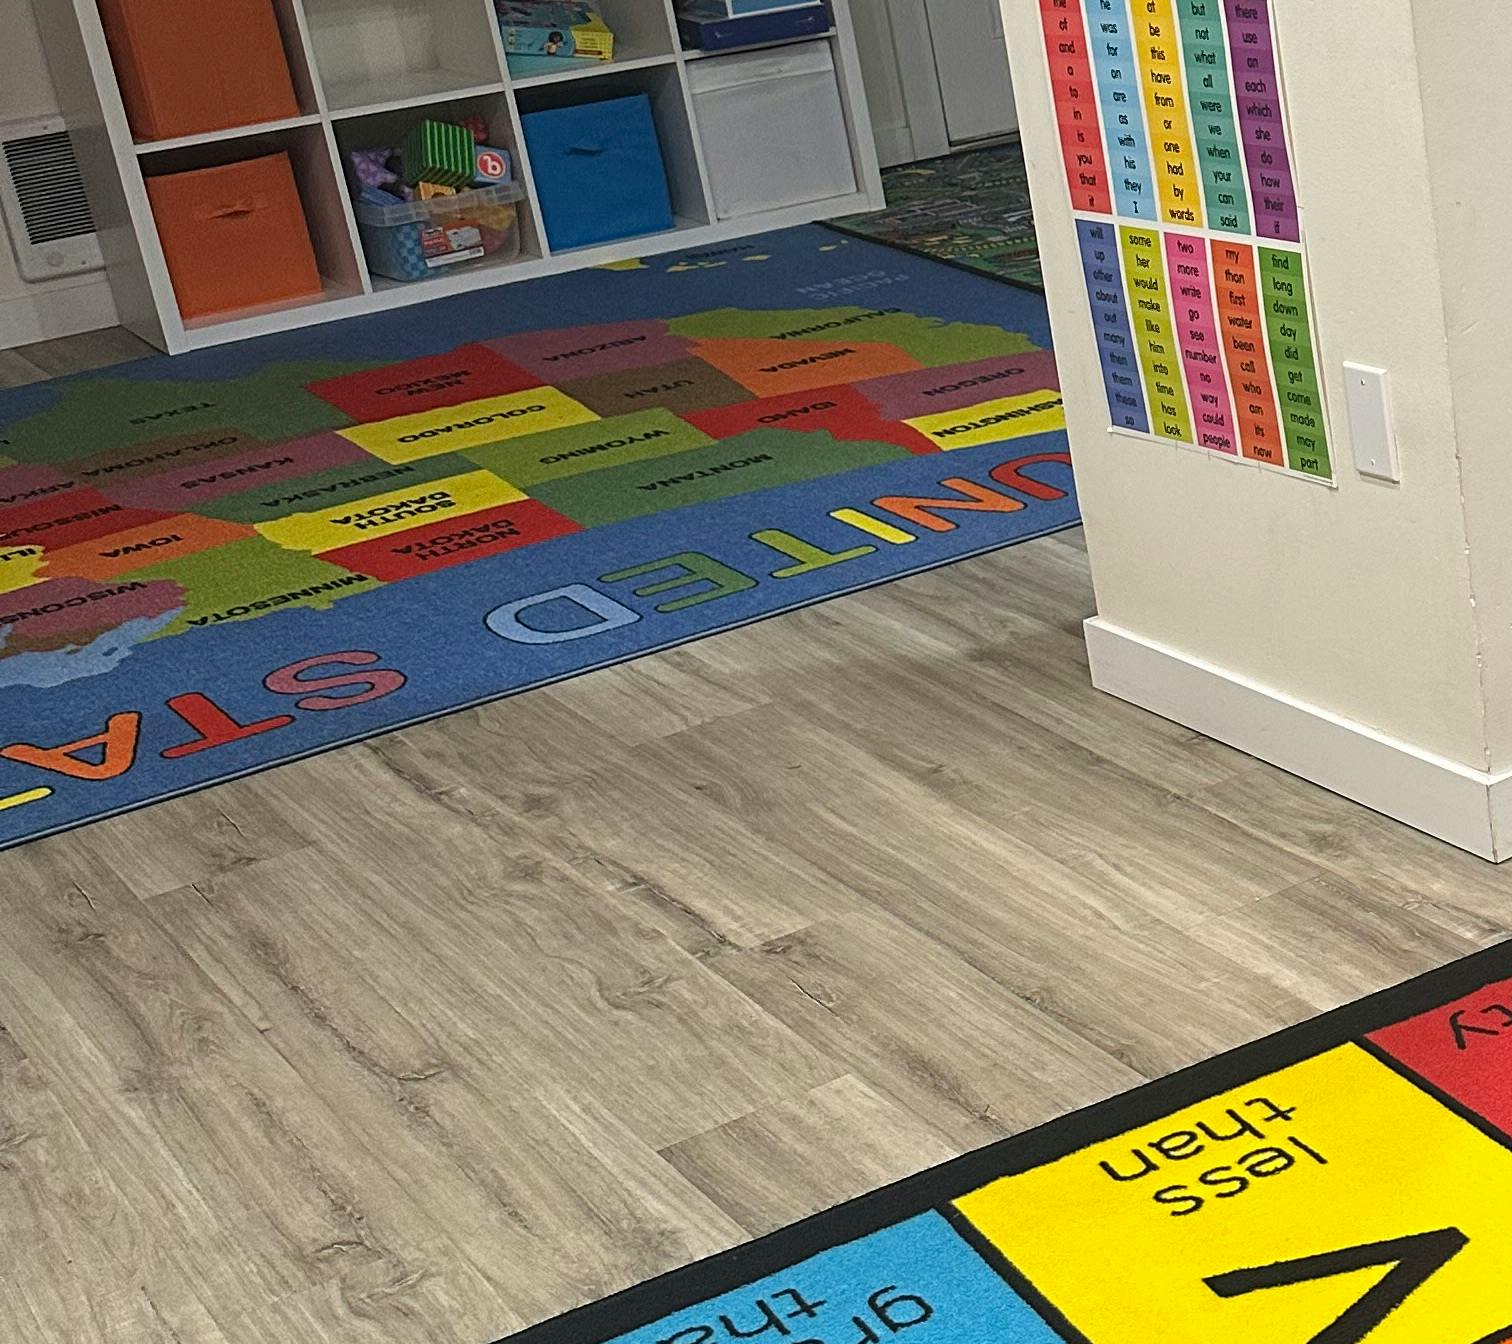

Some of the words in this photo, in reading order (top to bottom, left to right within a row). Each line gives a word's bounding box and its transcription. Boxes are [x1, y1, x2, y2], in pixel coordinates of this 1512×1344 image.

[1151, 70, 1171, 84] have
[1207, 144, 1231, 159] when
[1272, 254, 1289, 270] find
[796, 269, 887, 296] OCEAN
[1273, 277, 1293, 296] long
[1273, 300, 1298, 316] down
[769, 306, 902, 341] CALIFORNIA
[1280, 324, 1296, 341] day
[541, 335, 647, 362] ARIZONA
[757, 347, 856, 374] NEVADA
[375, 369, 472, 396] MEXICO
[407, 379, 465, 397] NEW
[624, 379, 696, 400] UTAH
[922, 367, 1026, 398] OREGON
[1288, 371, 1302, 384] get
[129, 401, 216, 426] TEXAS
[396, 404, 547, 443] COLORADO
[757, 400, 839, 425] IDAHO
[81, 435, 239, 478] OKLAHOMA
[538, 428, 671, 465] WYOMING
[180, 457, 295, 490] KANSAS
[259, 465, 416, 508] NEBRASKA
[636, 453, 774, 492] MONTANA
[330, 491, 451, 526] DAKOTA
[354, 499, 457, 530] SOUTH
[99, 533, 185, 558] IOWA
[391, 519, 516, 555] DAKOTA
[416, 527, 521, 561] NORTH
[485, 452, 1072, 645] UNITED
[185, 573, 370, 627] MINNESOTA
[1101, 1096, 1297, 1182] than
[1154, 1136, 1328, 1217] less
